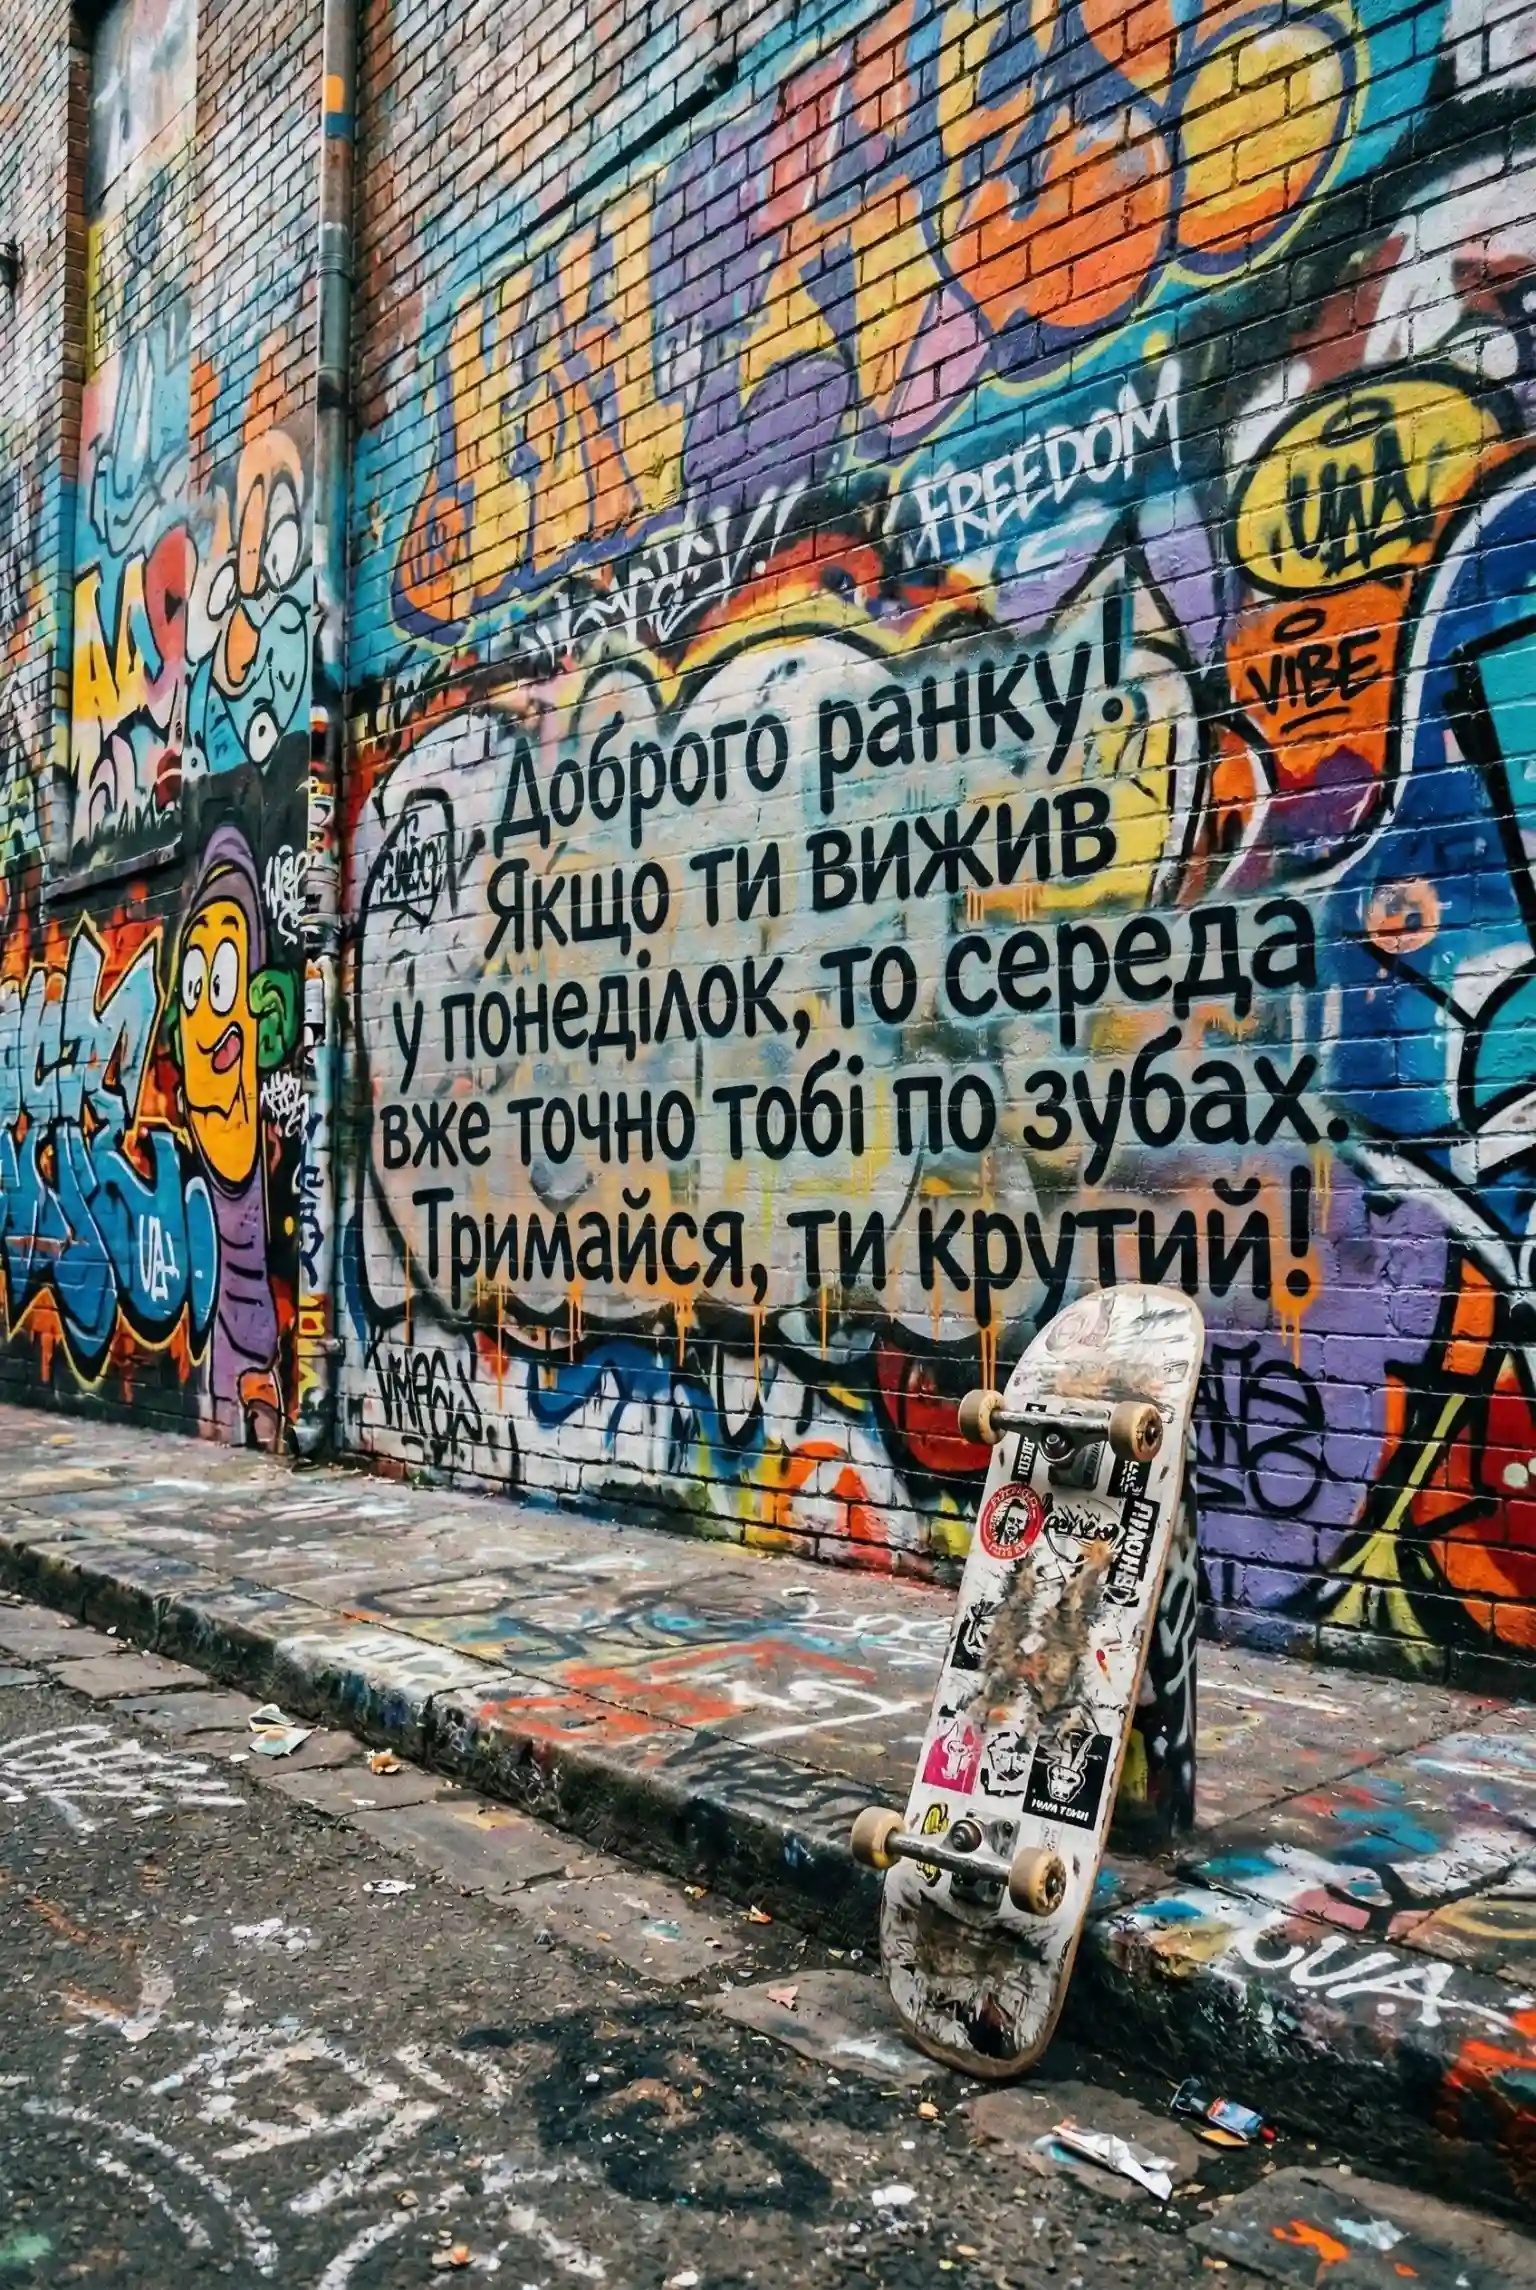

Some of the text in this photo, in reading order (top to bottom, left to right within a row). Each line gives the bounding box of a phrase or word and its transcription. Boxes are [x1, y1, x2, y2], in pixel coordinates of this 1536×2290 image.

[908, 360, 1183, 563] FREEDOM
[493, 711, 789, 857] Доброго
[819, 592, 1124, 814] ранку!
[1245, 629, 1382, 716] VIBE
[484, 787, 1117, 959] Якщо ти вижив
[394, 898, 1317, 1094] у понеділок, то середа
[380, 1101, 491, 1169] вже
[508, 1090, 695, 1166] точно
[713, 1049, 864, 1160] тобі
[893, 1074, 996, 1156] по
[1023, 1026, 1349, 1185] зубах.
[412, 1186, 768, 1311] Тримайся,
[787, 1208, 886, 1291] ти
[919, 1165, 1313, 1331] крутий!
